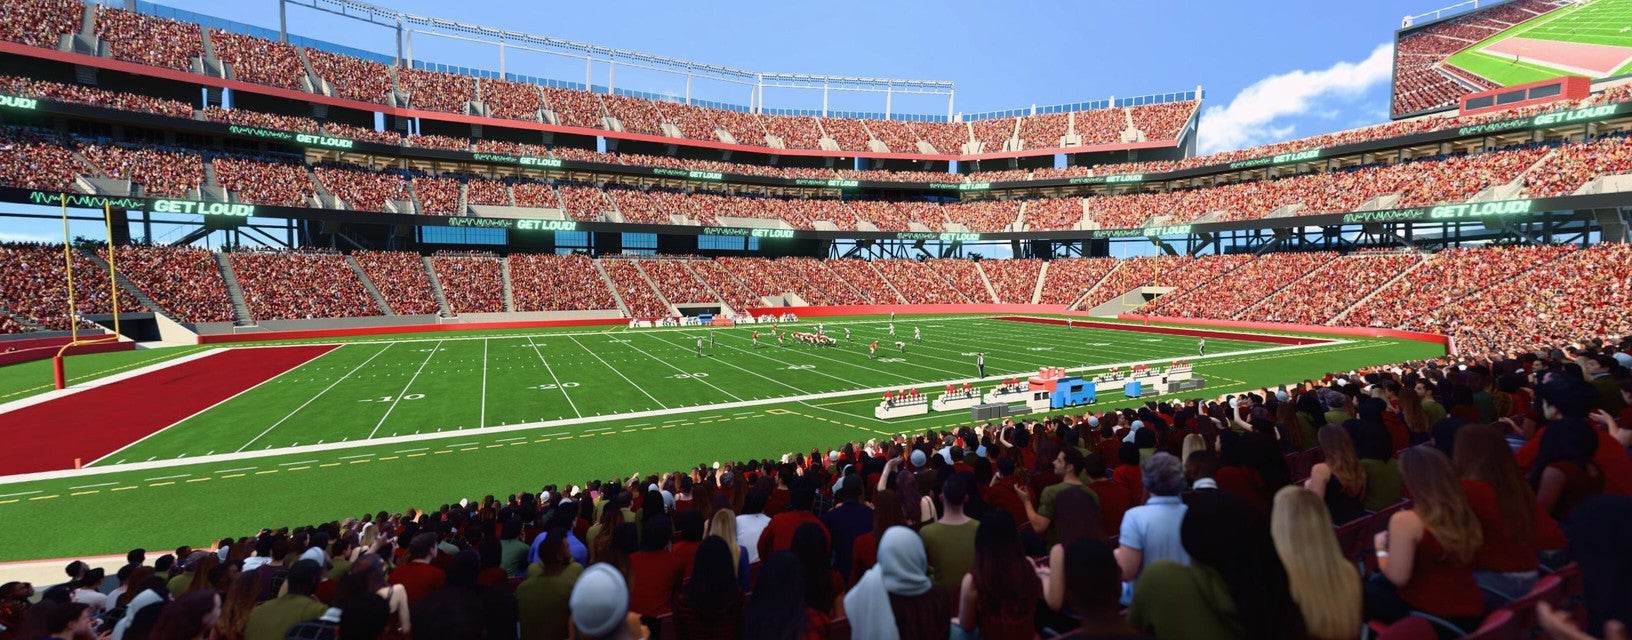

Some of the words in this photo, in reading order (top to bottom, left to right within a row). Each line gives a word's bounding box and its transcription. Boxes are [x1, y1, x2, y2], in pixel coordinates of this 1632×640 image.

[1534, 112, 1567, 125] GET
[1566, 104, 1618, 120] LOUD!
[297, 134, 320, 144] GET
[320, 137, 353, 148] LOUD!
[520, 157, 537, 165] GET
[537, 158, 562, 167] LOUD!
[1273, 154, 1292, 163] GET
[1291, 149, 1319, 161] LOUD!
[154, 200, 197, 213] GET
[198, 202, 255, 216] LOUD!
[1430, 205, 1470, 218] GET
[1469, 199, 1532, 216] LOUD!
[517, 219, 542, 230] GET
[542, 220, 576, 231] LOUD!
[1143, 227, 1162, 237] GET
[1162, 225, 1192, 236] LOUD!
[752, 228, 770, 238] GET
[770, 229, 795, 238] LOUD!
[940, 232, 957, 241] GET
[956, 232, 981, 241] LOUD!
